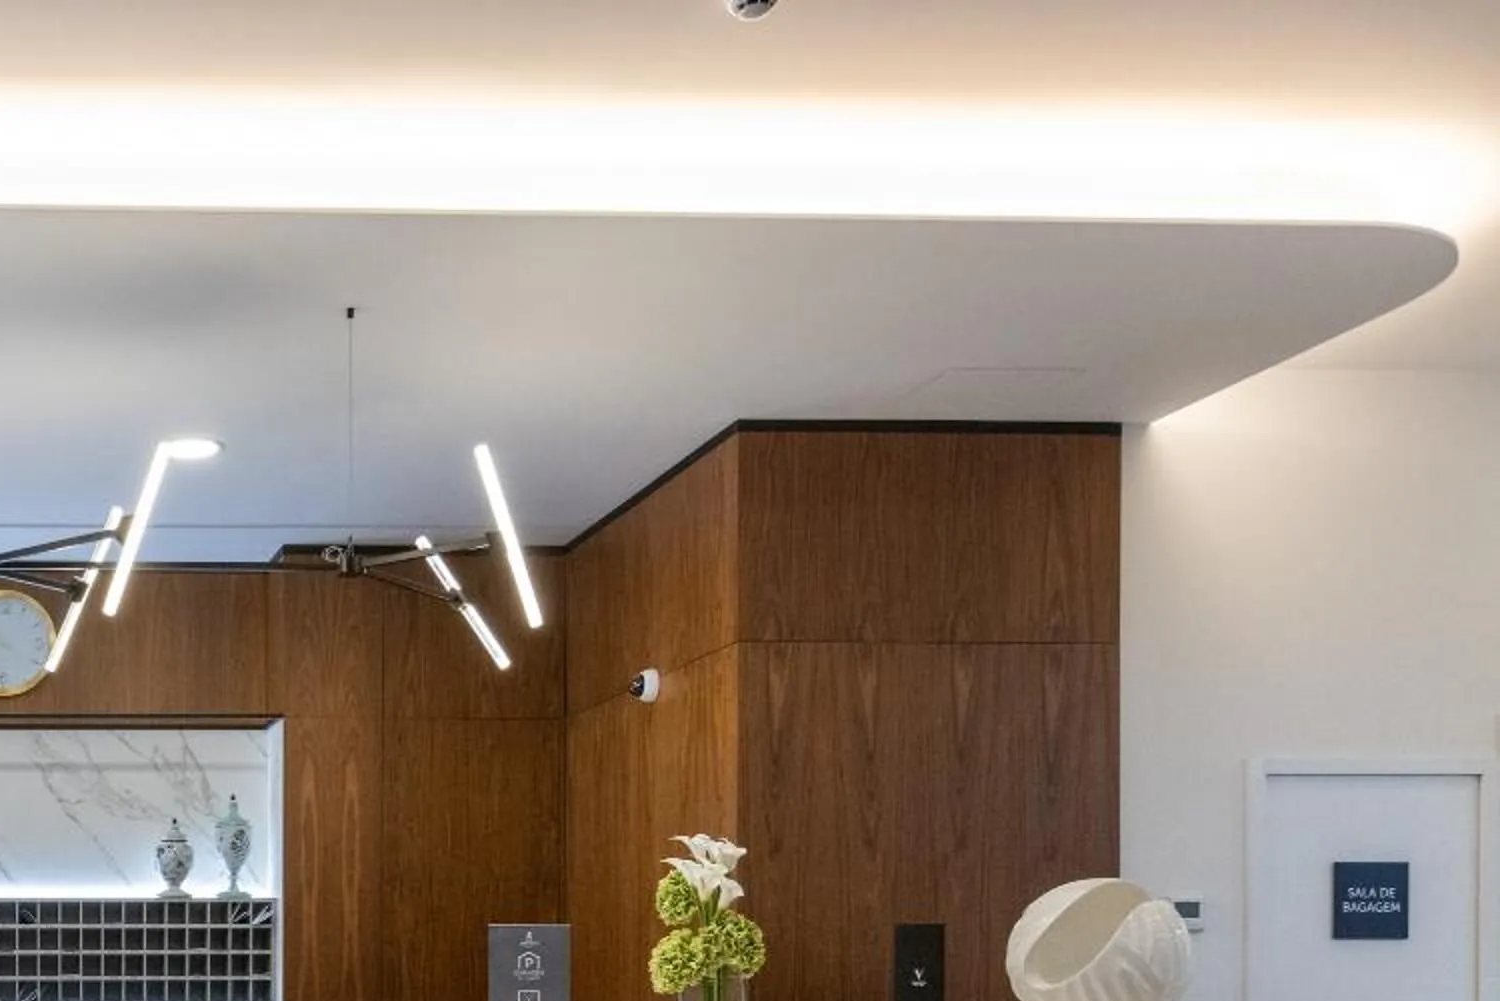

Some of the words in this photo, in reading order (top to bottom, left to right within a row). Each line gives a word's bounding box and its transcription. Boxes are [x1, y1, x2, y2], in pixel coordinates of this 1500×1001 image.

[1347, 887, 1377, 899] SALA
[1379, 887, 1397, 899] DE
[1343, 901, 1401, 913] BAGAGEM
